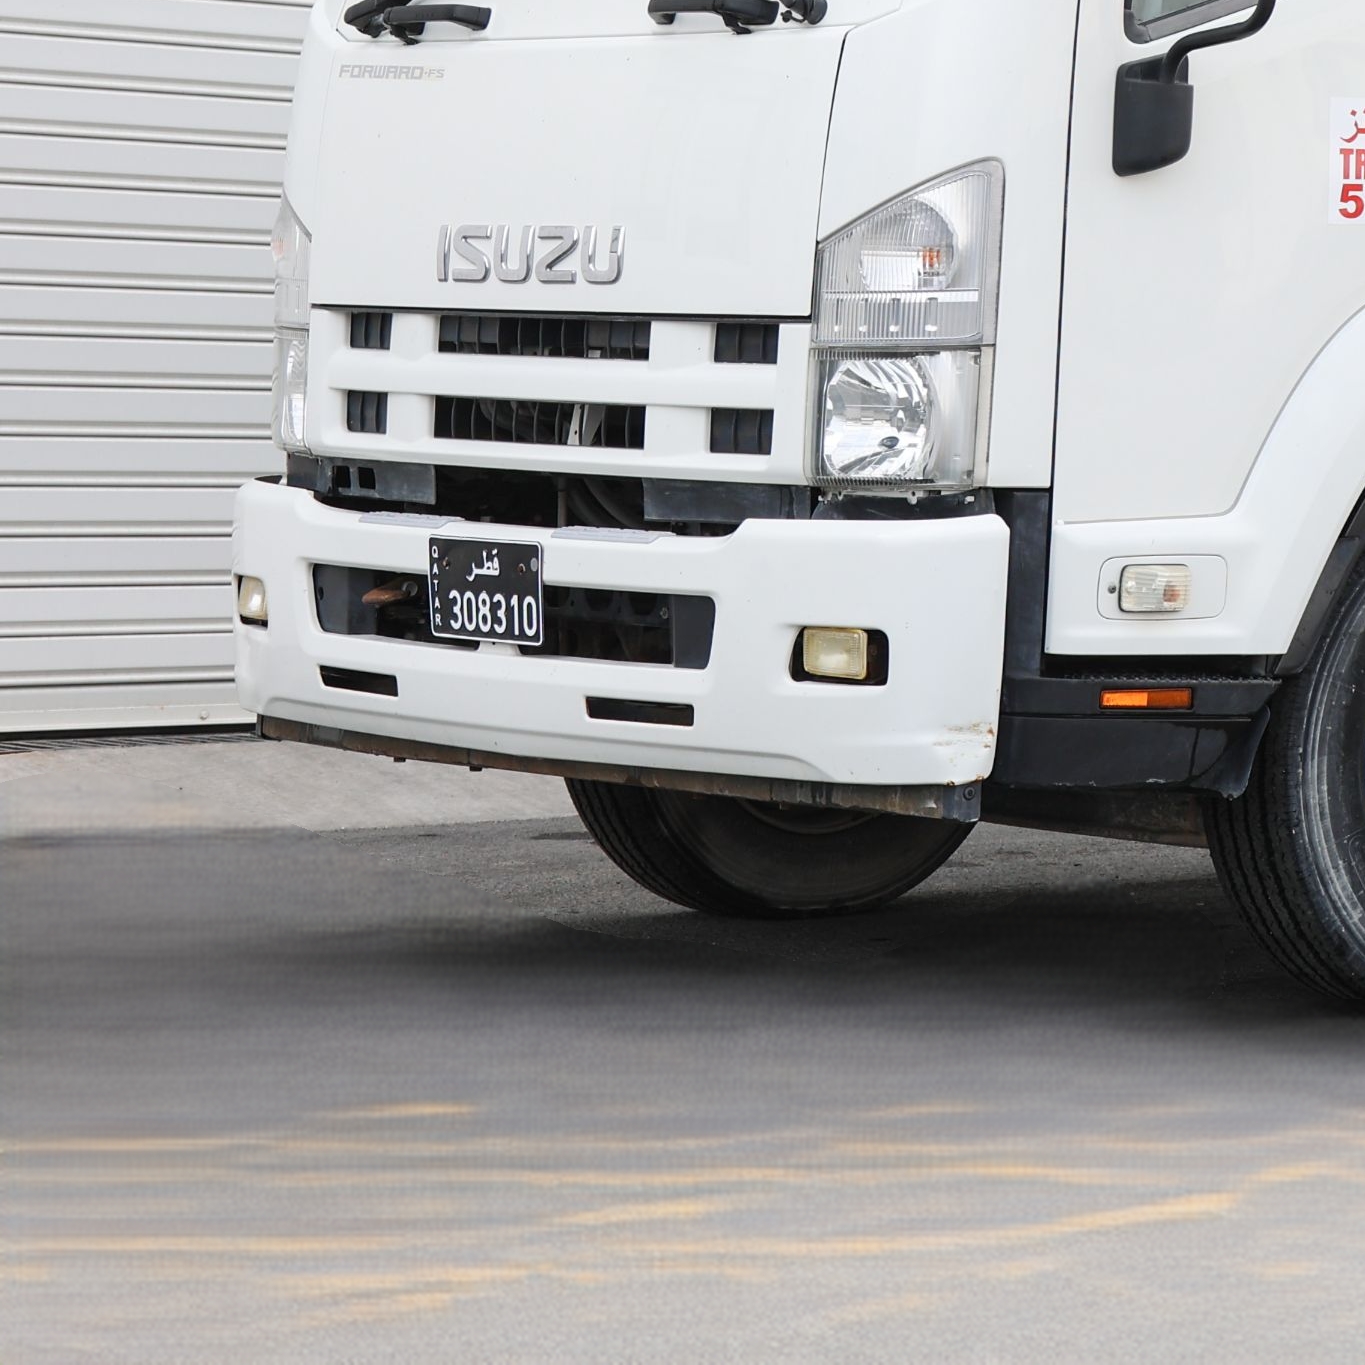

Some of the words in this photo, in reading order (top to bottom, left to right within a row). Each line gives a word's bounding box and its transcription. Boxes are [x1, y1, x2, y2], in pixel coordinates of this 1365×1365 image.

[436, 223, 627, 285] ISUZU
[431, 545, 442, 627] QATAR
[466, 548, 500, 582] قطر
[448, 589, 538, 637] 308310
